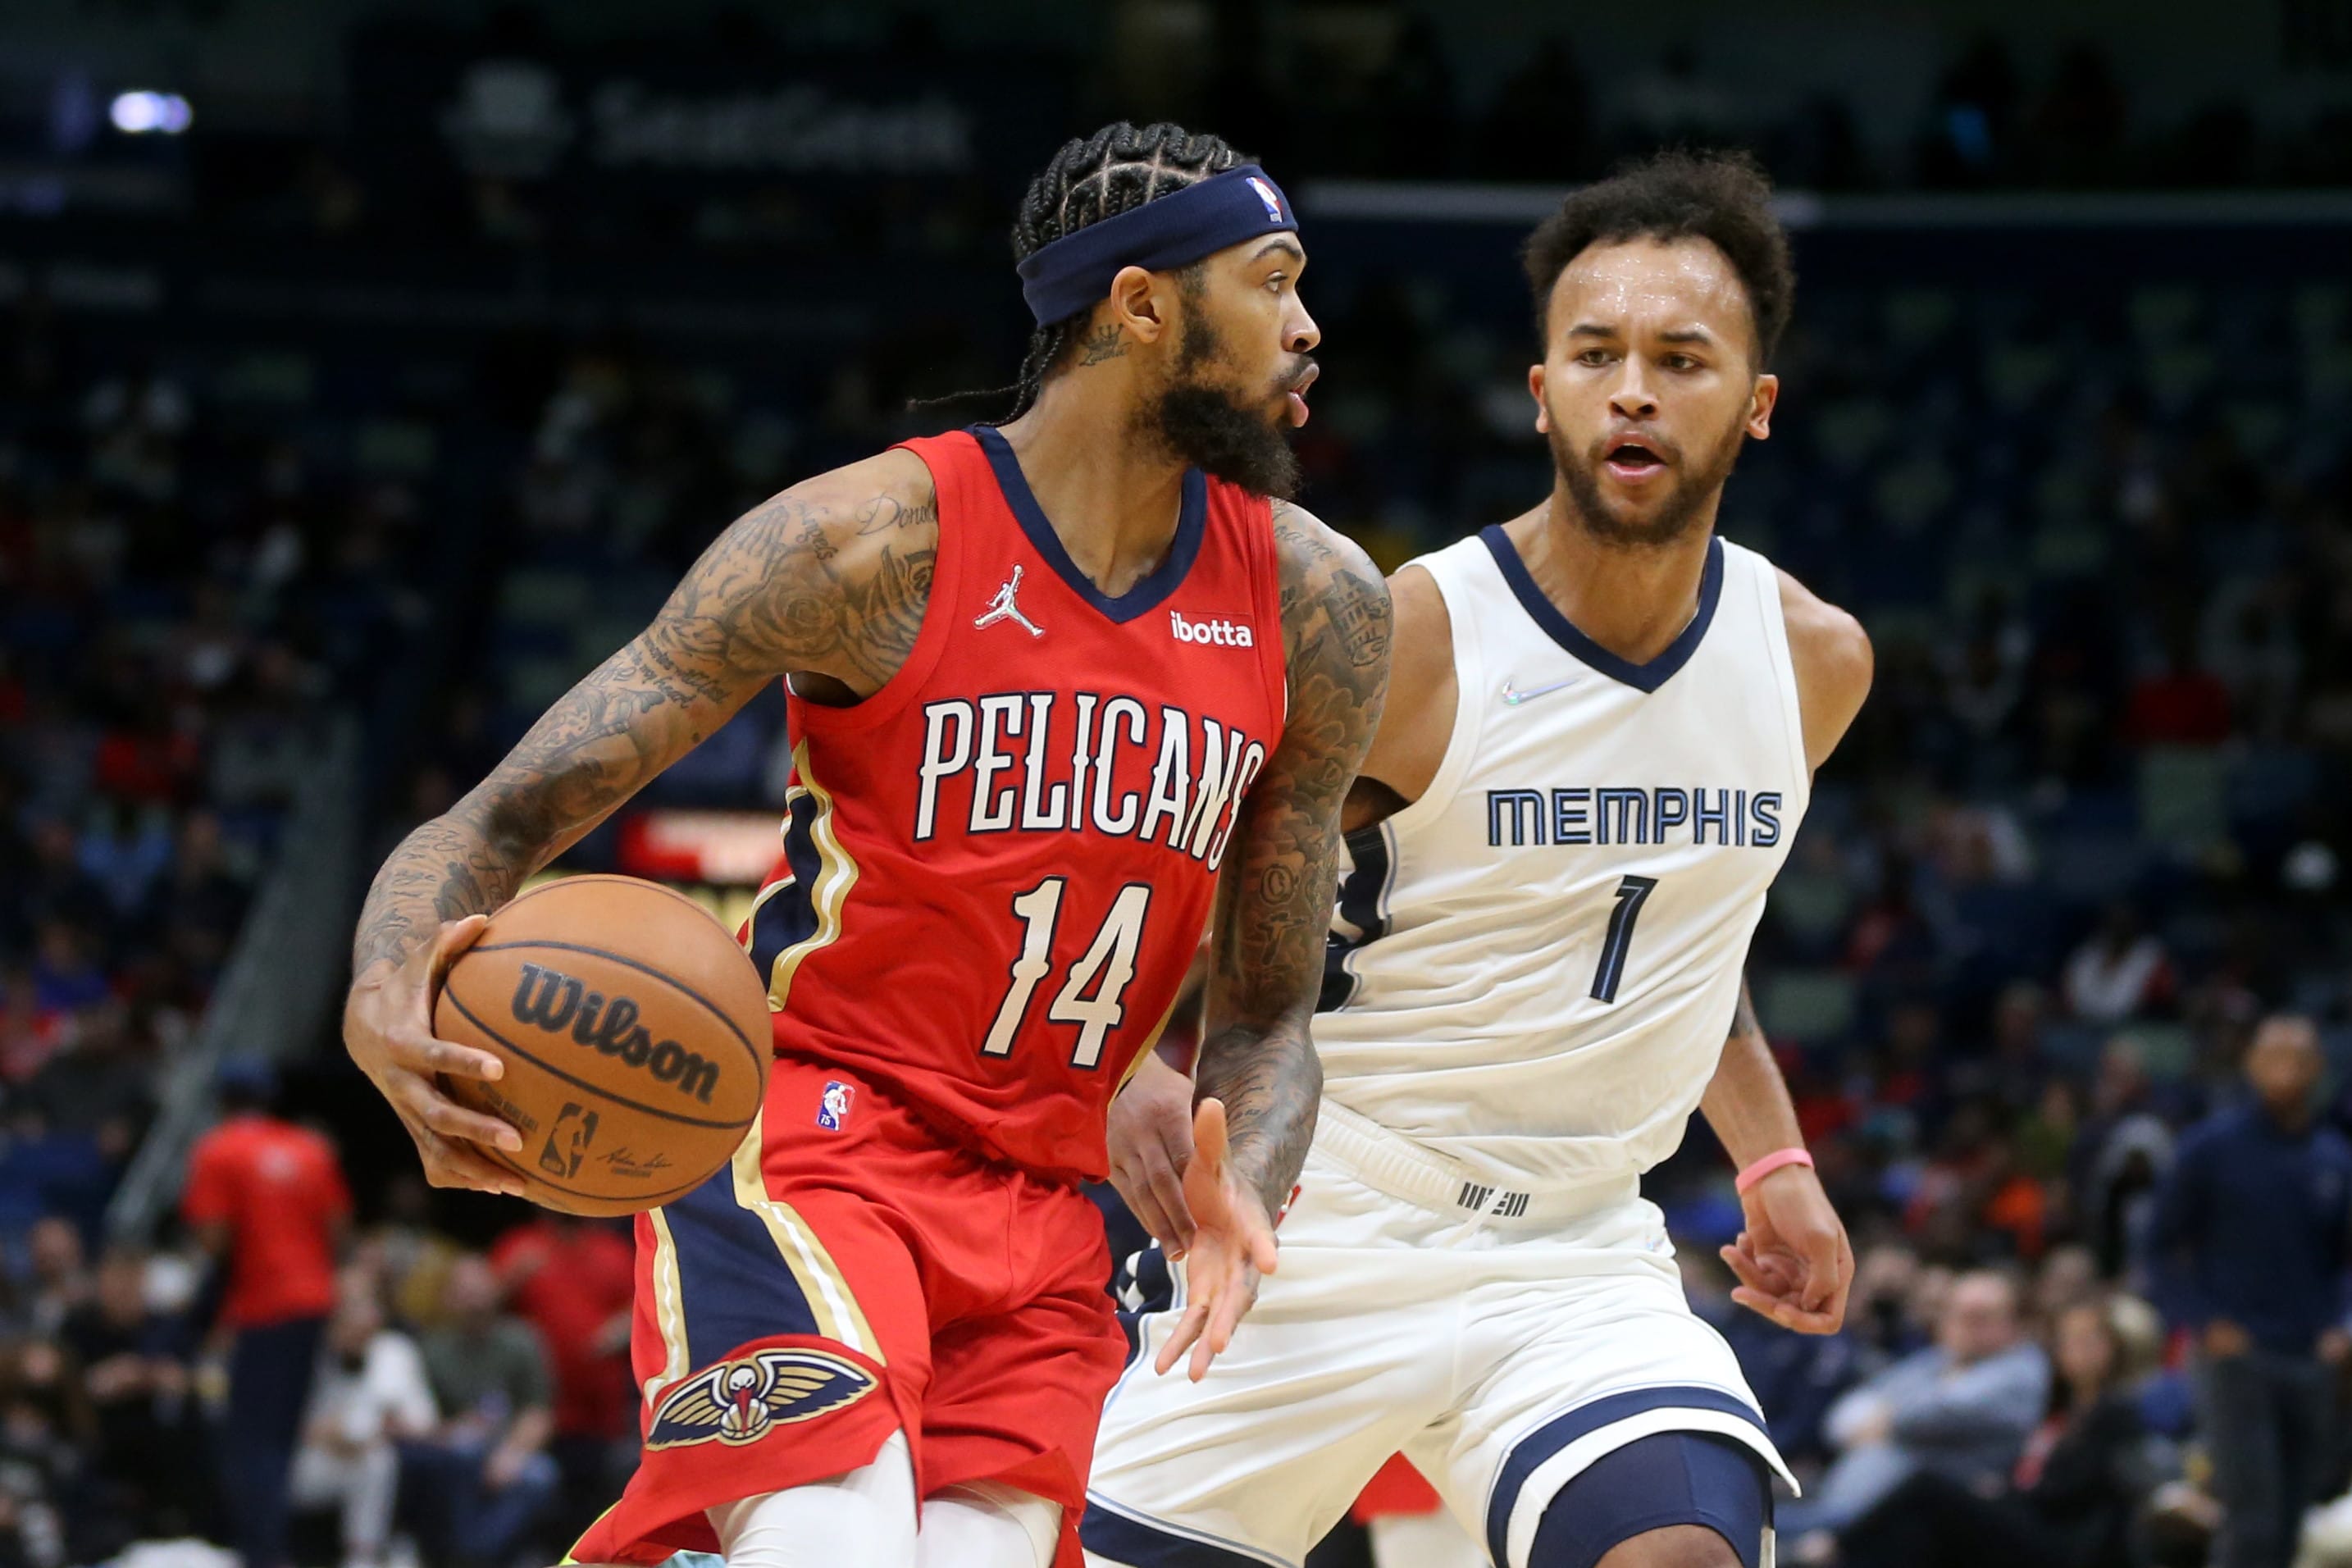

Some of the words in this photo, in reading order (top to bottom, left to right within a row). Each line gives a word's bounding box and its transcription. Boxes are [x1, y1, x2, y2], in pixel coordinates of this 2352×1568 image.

[1169, 609, 1254, 648] ibotta
[913, 691, 1267, 873] PELICANS
[1487, 787, 1782, 847] MEMPHIS
[979, 873, 1154, 1071] 14
[1589, 874, 1660, 1005] 1
[511, 962, 720, 1106] Wilson
